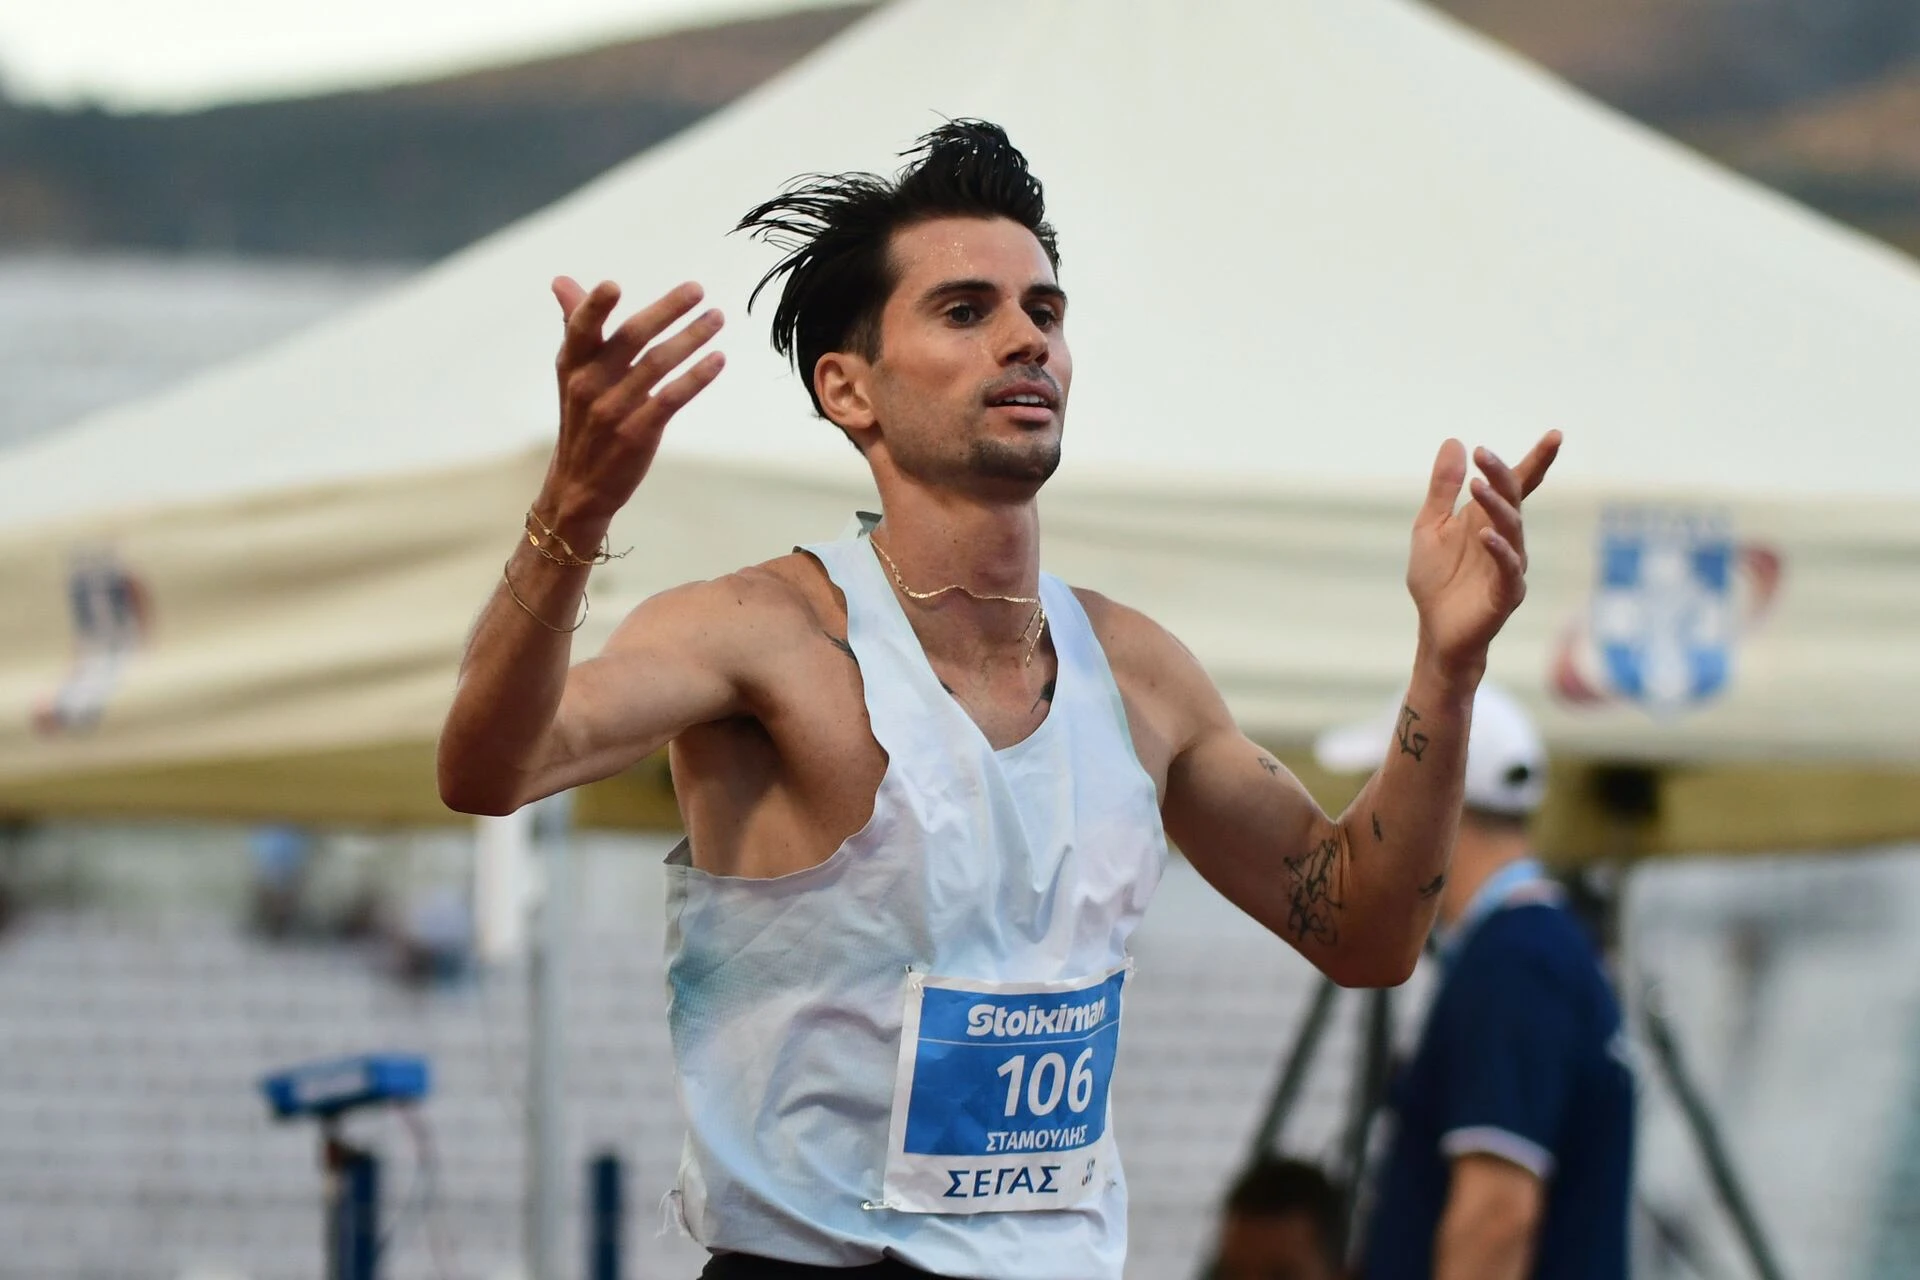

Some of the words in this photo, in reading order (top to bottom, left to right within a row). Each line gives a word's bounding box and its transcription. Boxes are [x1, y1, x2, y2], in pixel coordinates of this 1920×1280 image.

[967, 997, 1104, 1036] Stoiximan
[997, 1047, 1093, 1117] 106
[986, 1125, 1087, 1151] ΣΤΑΜΟΥΛΗΣ
[944, 1166, 1061, 1198] ΣΕΓΑΣ
